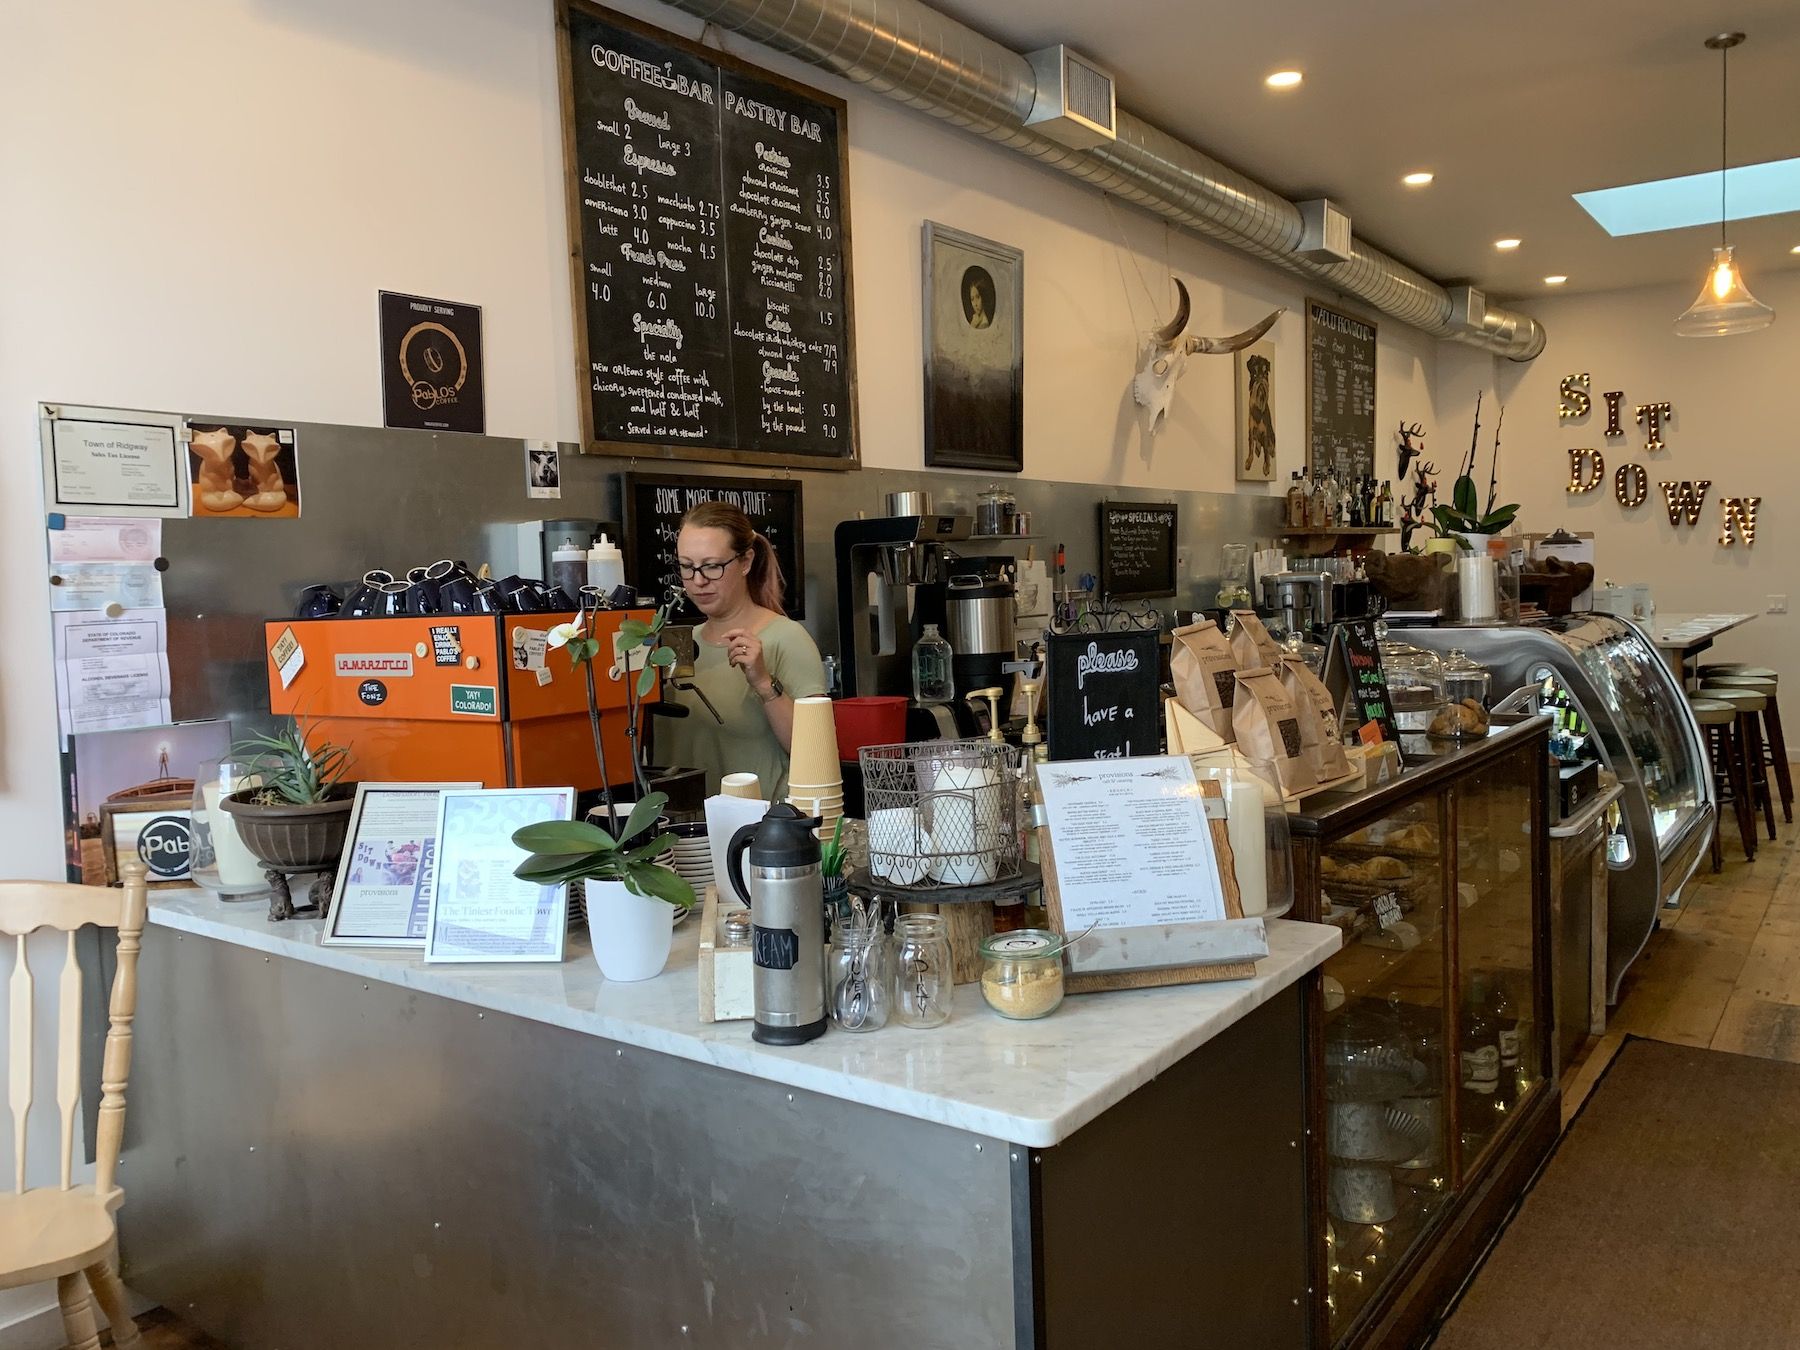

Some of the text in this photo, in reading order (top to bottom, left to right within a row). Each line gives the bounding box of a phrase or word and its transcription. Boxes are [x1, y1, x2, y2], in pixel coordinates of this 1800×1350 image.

[591, 44, 714, 105] COFFEE BAR
[725, 90, 822, 143] PASTRY BAR
[597, 120, 632, 140] small 2
[685, 142, 691, 157] 3
[631, 181, 649, 200] 2.5
[742, 170, 768, 188] almond
[816, 189, 830, 205] 3.5
[816, 174, 830, 189] 3.5
[632, 204, 648, 221] 3.0
[657, 192, 720, 219] macchiato 2.75
[816, 204, 831, 219] 4.0
[658, 215, 716, 237] cappuccino 3.5
[817, 225, 832, 240] 4.0
[633, 226, 649, 245] 4.0
[667, 236, 716, 260] mocha 4.5
[589, 262, 612, 277] small
[787, 255, 799, 270] chip
[818, 256, 832, 272] 2.5
[819, 272, 832, 286] 2.0
[819, 284, 832, 299] 2.0
[410, 302, 454, 316] PROUDLY SERVING
[591, 282, 716, 320] 4.0 6.0 10.0
[766, 297, 833, 326] biscotti 1.5
[660, 349, 678, 364] nola
[693, 369, 710, 387] with
[630, 398, 700, 420] and half & half
[762, 397, 771, 415] by
[823, 403, 836, 417] 5.0
[1560, 373, 1671, 450] SIT
[761, 414, 771, 433] by
[823, 424, 837, 438] 9.0
[82, 439, 148, 452] Town of Ridgway
[655, 488, 681, 514] SOME
[1566, 449, 1762, 545] DOWN
[1128, 512, 1158, 523] SPECIALS
[1078, 641, 1139, 690] please
[465, 690, 480, 700] YAY!
[455, 700, 492, 711] COLORADO!
[1125, 707, 1135, 719] a
[359, 842, 373, 855] SIT
[358, 854, 381, 870] DOWN
[754, 931, 793, 968] REAM
